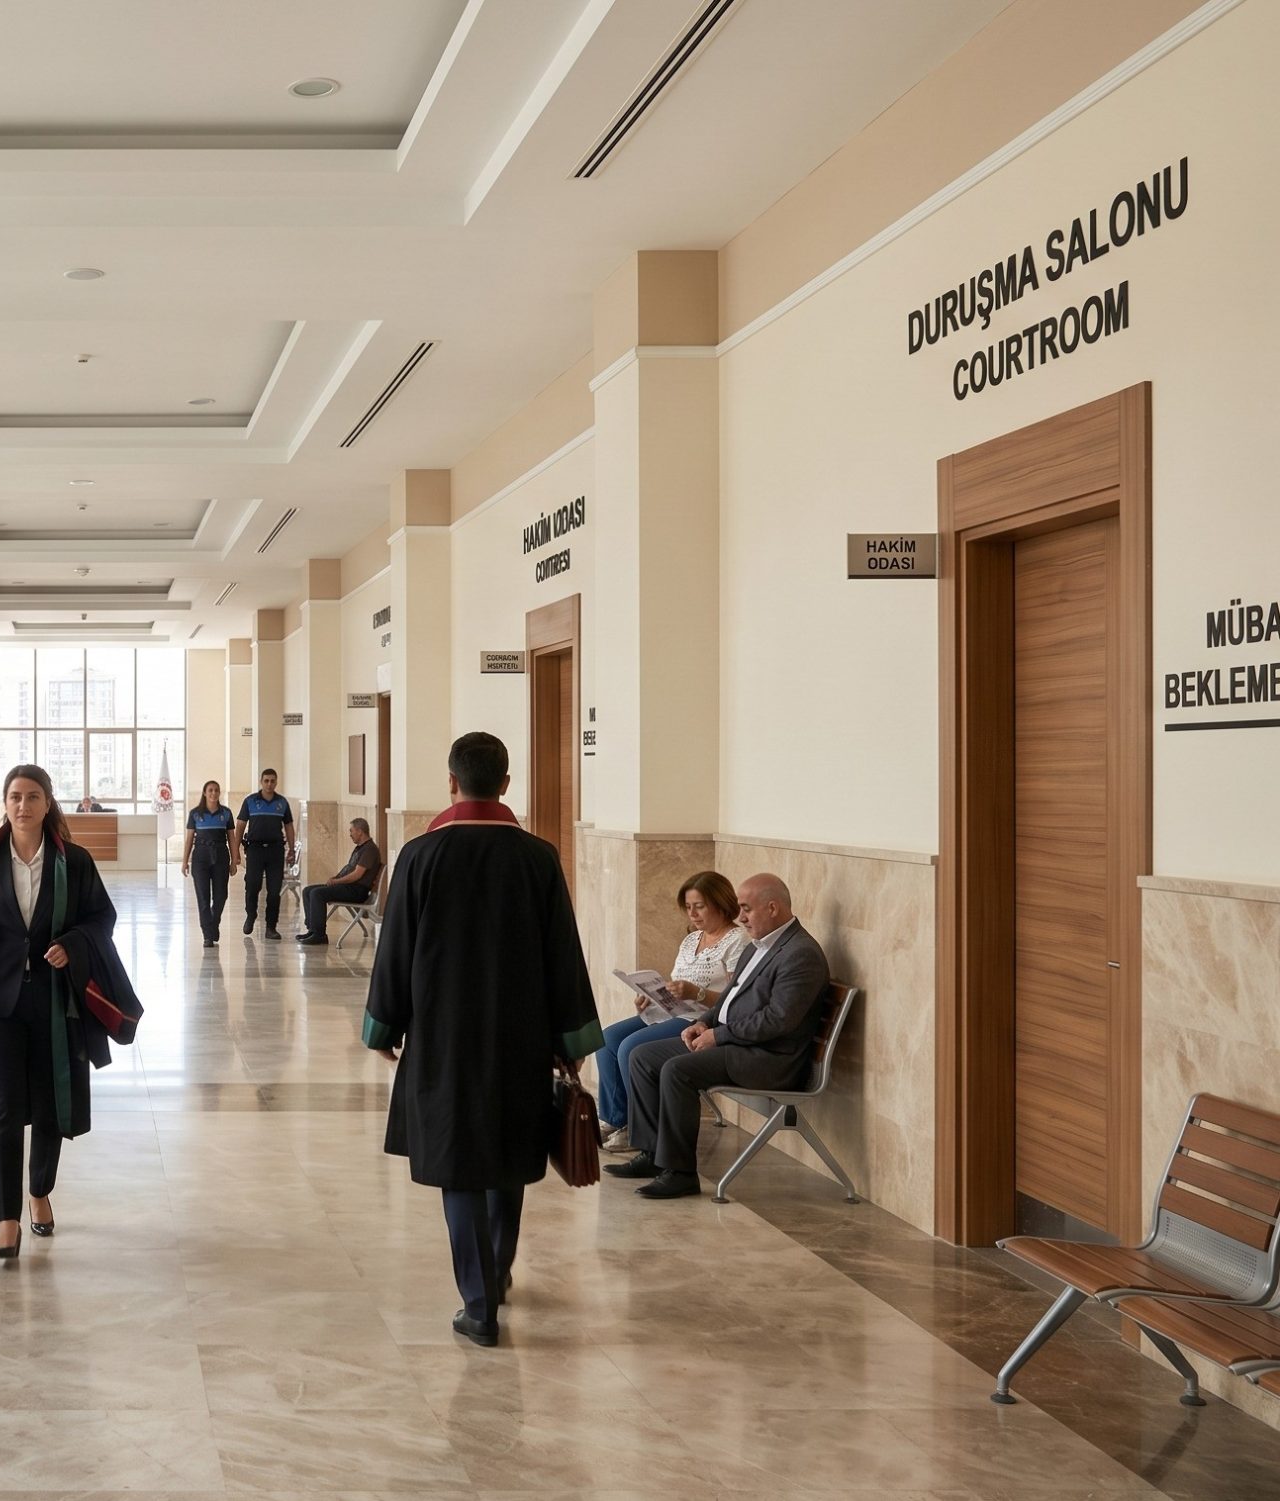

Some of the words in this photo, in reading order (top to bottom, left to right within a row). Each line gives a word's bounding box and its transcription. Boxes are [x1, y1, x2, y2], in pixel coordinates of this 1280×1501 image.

[908, 245, 1039, 355] DURUŞMA
[1045, 156, 1188, 282] SALONU
[953, 280, 1129, 401] COURTROOM
[866, 537, 916, 553] HAKİM
[867, 557, 915, 570] ODASI
[1206, 598, 1280, 649] MÜBA
[1165, 662, 1280, 709] BEKLEME
